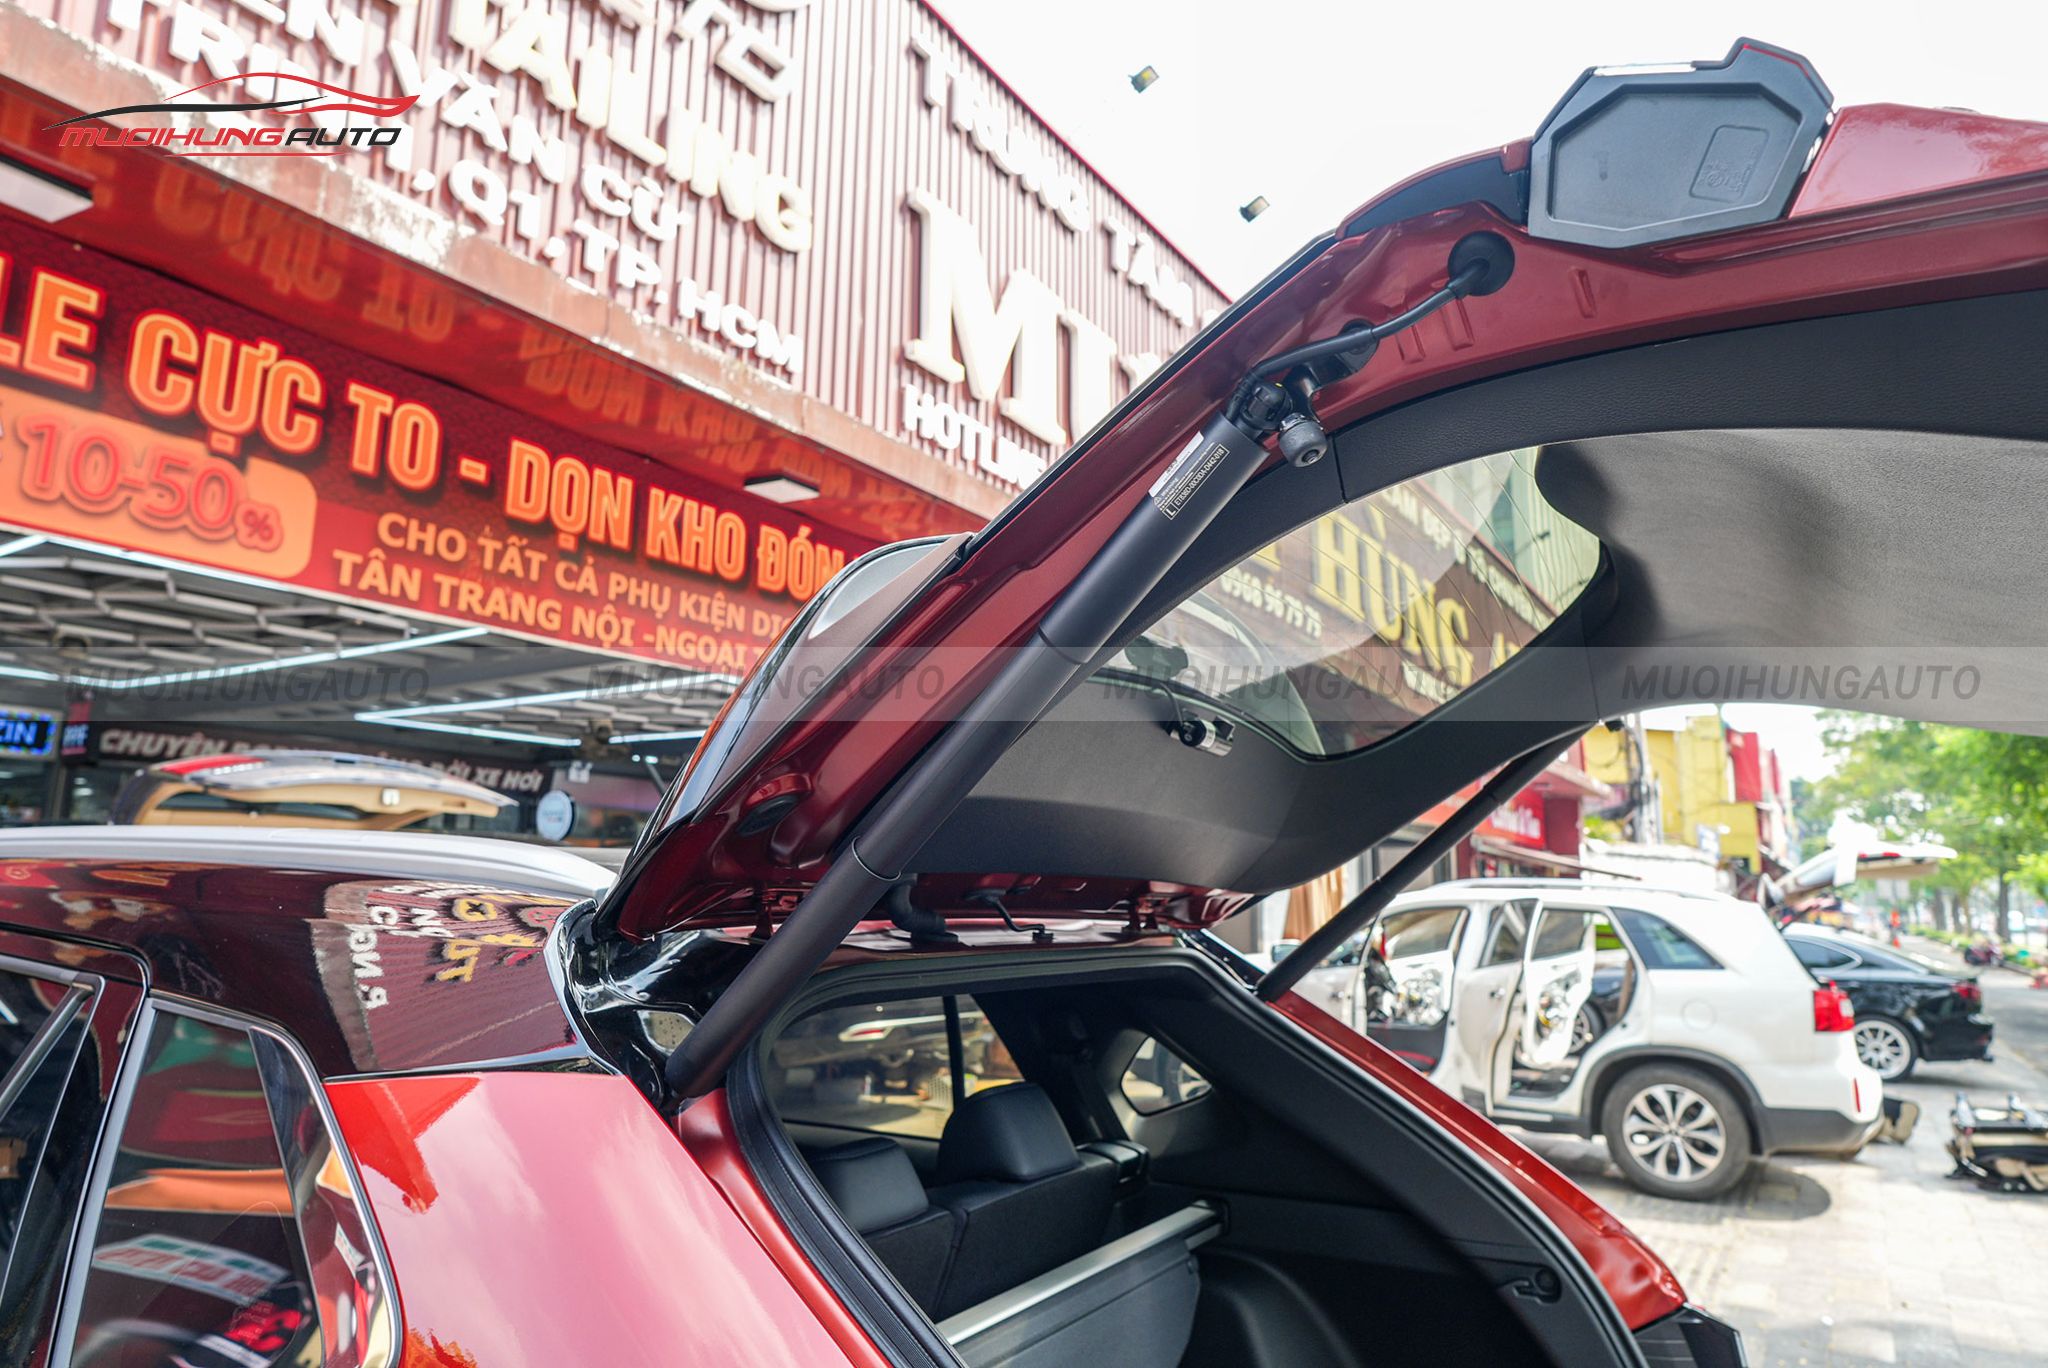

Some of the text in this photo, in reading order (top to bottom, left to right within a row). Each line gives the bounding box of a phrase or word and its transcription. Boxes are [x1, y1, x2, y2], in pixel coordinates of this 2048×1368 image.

[129, 312, 324, 456] CỰC
[347, 382, 440, 491] TO
[505, 440, 633, 551] DỌN
[645, 486, 746, 581] KHO
[333, 547, 422, 602] TÂN
[433, 573, 562, 631] TRANG
[571, 603, 635, 649] NỘI
[377, 511, 467, 563] CHO
[555, 555, 599, 598] CẢ
[608, 571, 671, 620] PHỤ
[679, 590, 746, 633] KIỆN
